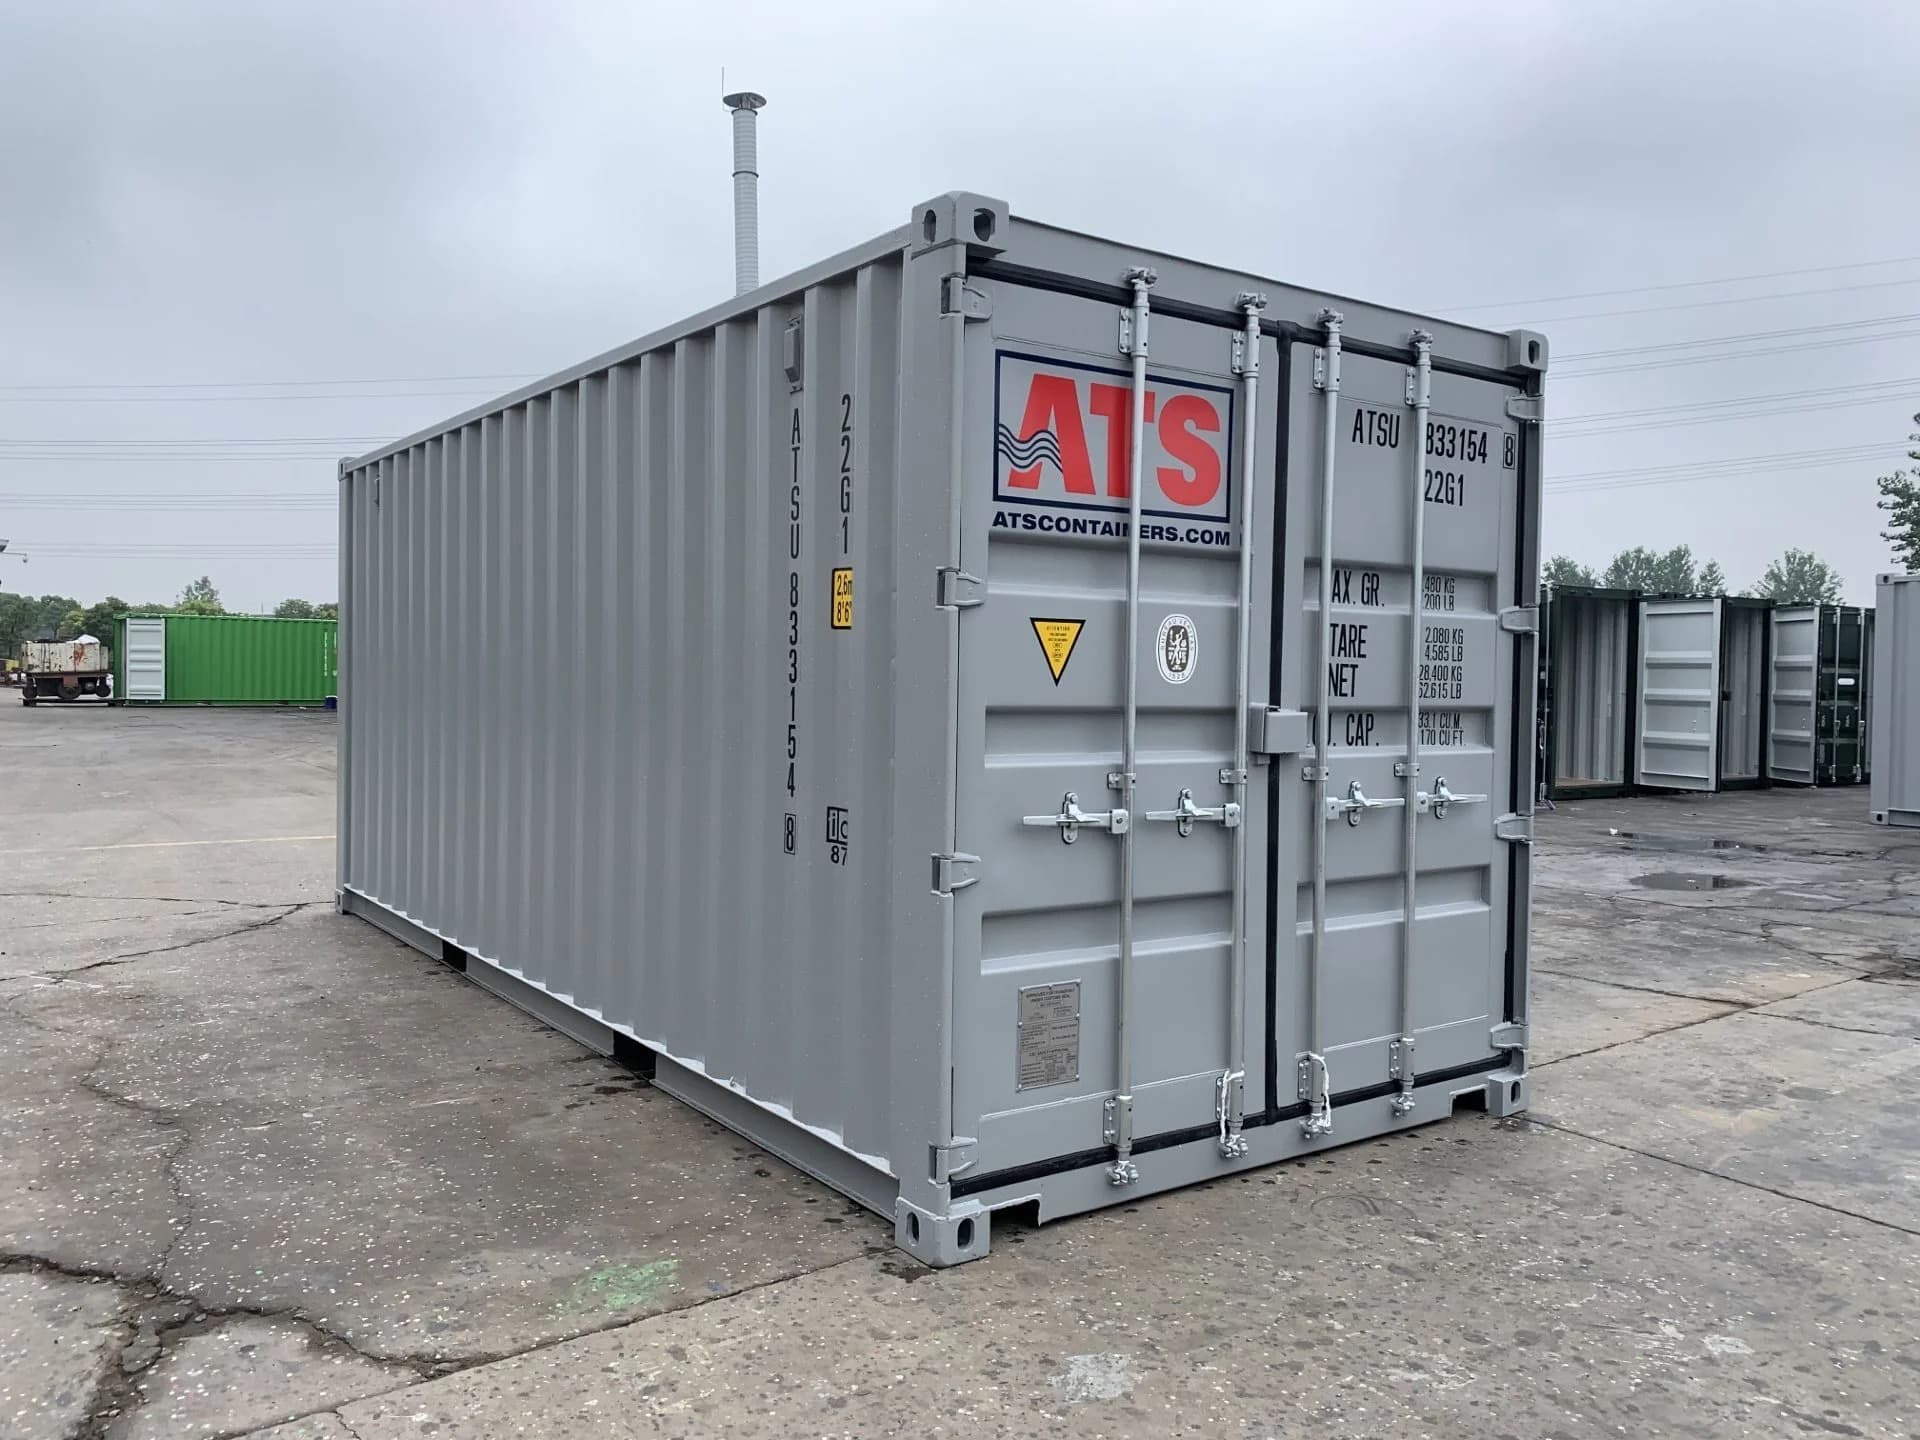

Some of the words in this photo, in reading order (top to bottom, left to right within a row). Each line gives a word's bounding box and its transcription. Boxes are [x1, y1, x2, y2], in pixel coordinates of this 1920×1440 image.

[1007, 373, 1221, 507] ATS
[1352, 409, 1400, 448] ATSU
[1425, 422, 1488, 464] 833154
[1504, 435, 1514, 467] 8
[790, 408, 801, 559] ATSU
[840, 393, 851, 554] 22G1
[1424, 469, 1464, 507] 22G1
[1331, 569, 1356, 605] AX.
[1361, 572, 1385, 607] GR.
[1422, 575, 1441, 593] .480
[1444, 575, 1455, 594] KG
[1444, 595, 1455, 611] LB
[1330, 622, 1368, 659] TARE
[1425, 626, 1450, 644] 2.080
[1452, 628, 1464, 645] KG
[1424, 644, 1449, 661] 4.585
[1451, 646, 1463, 662] LB
[786, 572, 799, 798] 833154
[1328, 663, 1359, 697] NET
[1450, 683, 1461, 699] LB
[1451, 666, 1462, 682] KG
[1346, 713, 1380, 747] CAP.
[786, 816, 794, 851] 8
[830, 845, 848, 866] 87
